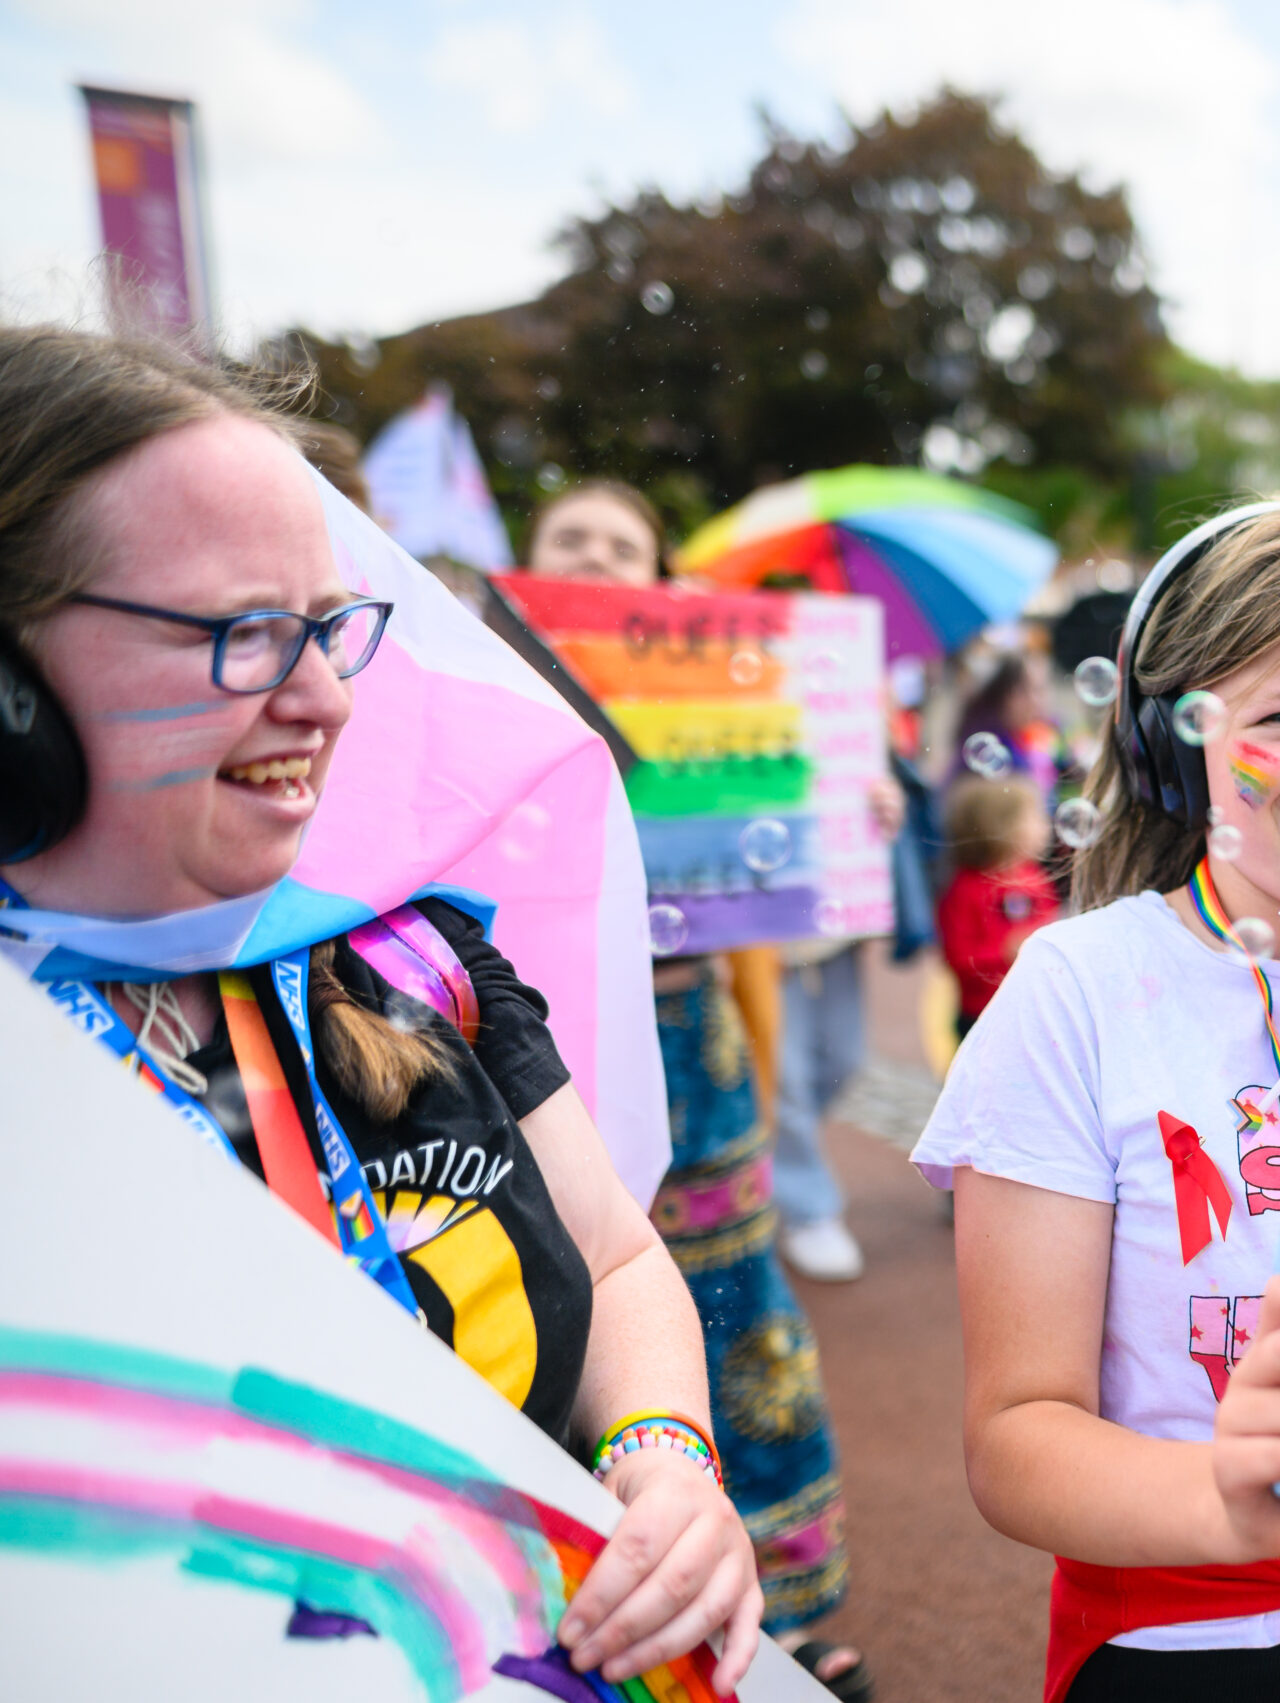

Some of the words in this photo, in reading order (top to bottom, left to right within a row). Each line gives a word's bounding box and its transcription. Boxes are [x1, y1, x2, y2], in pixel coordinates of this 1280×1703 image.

[276, 961, 304, 1030] NHS
[315, 1103, 350, 1182] NHS
[318, 1139, 514, 1199] DATION
